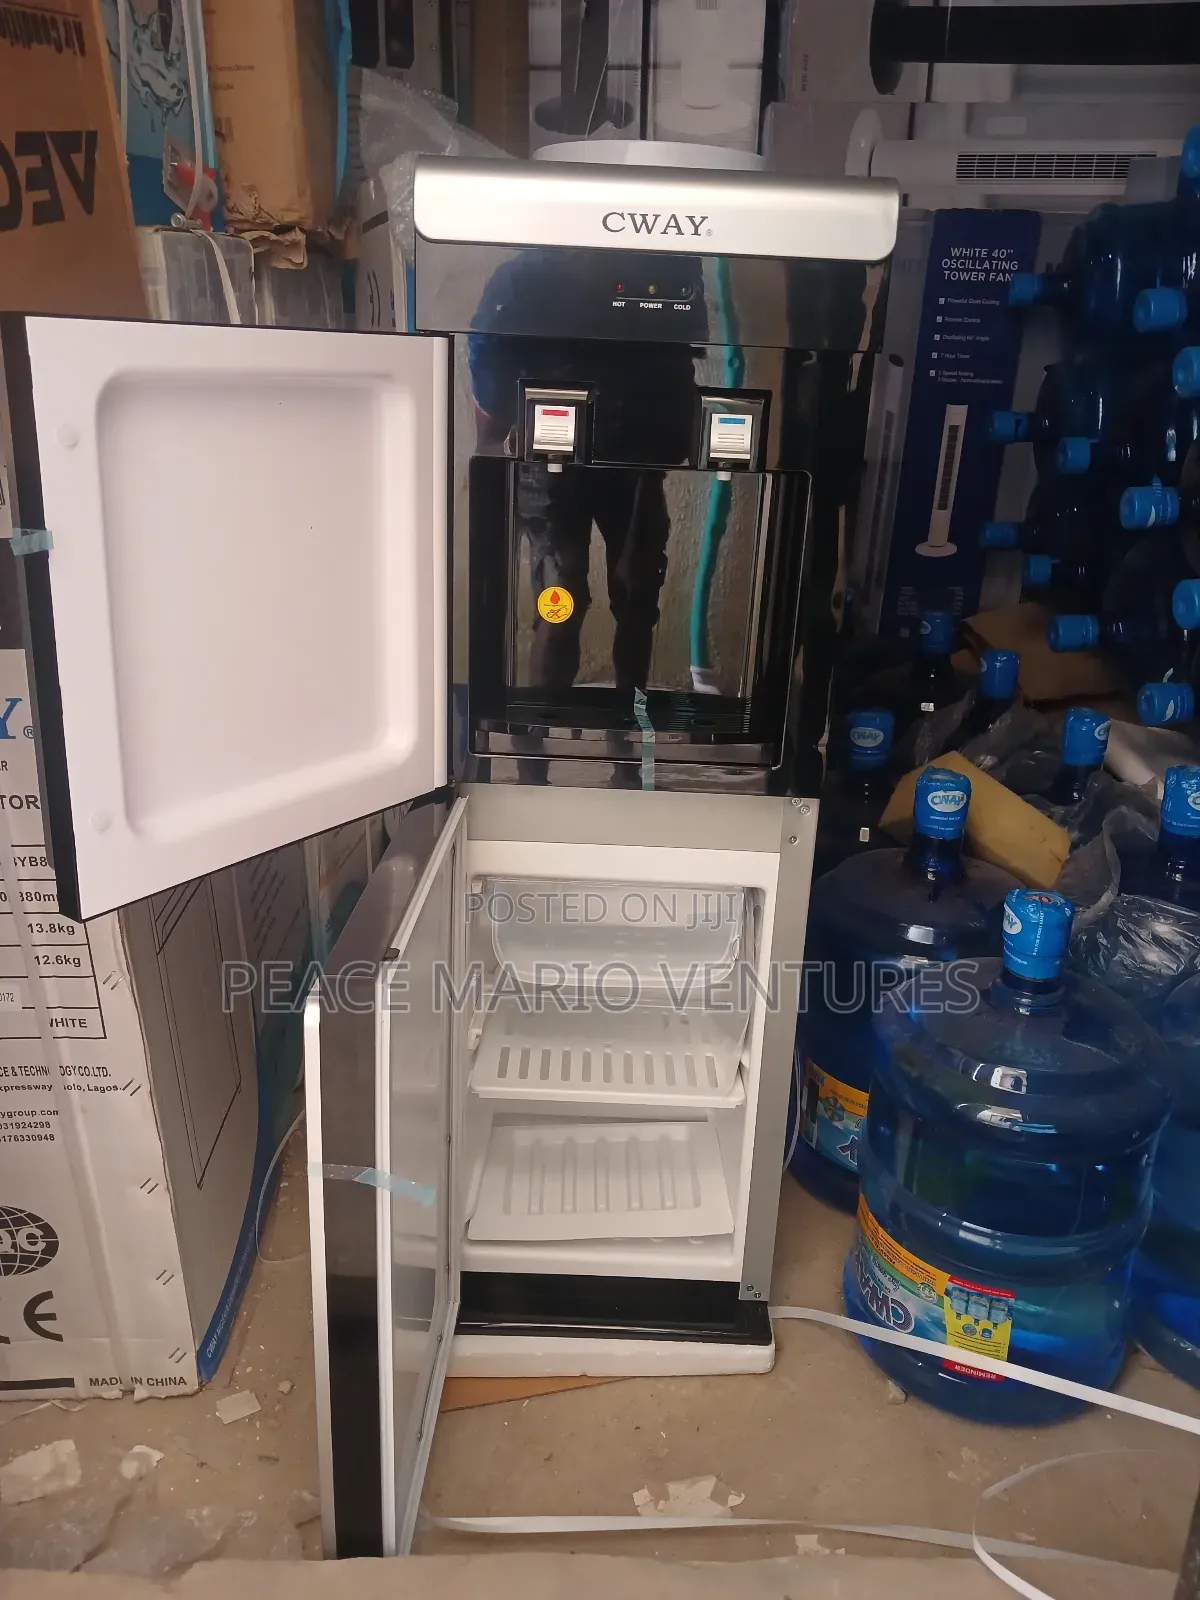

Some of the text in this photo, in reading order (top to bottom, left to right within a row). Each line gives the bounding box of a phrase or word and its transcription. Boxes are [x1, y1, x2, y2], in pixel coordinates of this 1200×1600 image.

[602, 211, 708, 236] CWAY
[950, 247, 988, 258] WHITE
[941, 258, 1019, 271] OSCILLATING
[943, 270, 1014, 282] TOWER FAN
[27, 923, 75, 936] 13.8kg
[34, 954, 81, 967] 12.6kg
[11, 1066, 18, 1077] &
[0, 1133, 56, 1143] 176330948
[954, 1364, 997, 1380] REMINDER
[89, 1377, 122, 1387] MAD
[146, 1376, 187, 1387] CHINA
